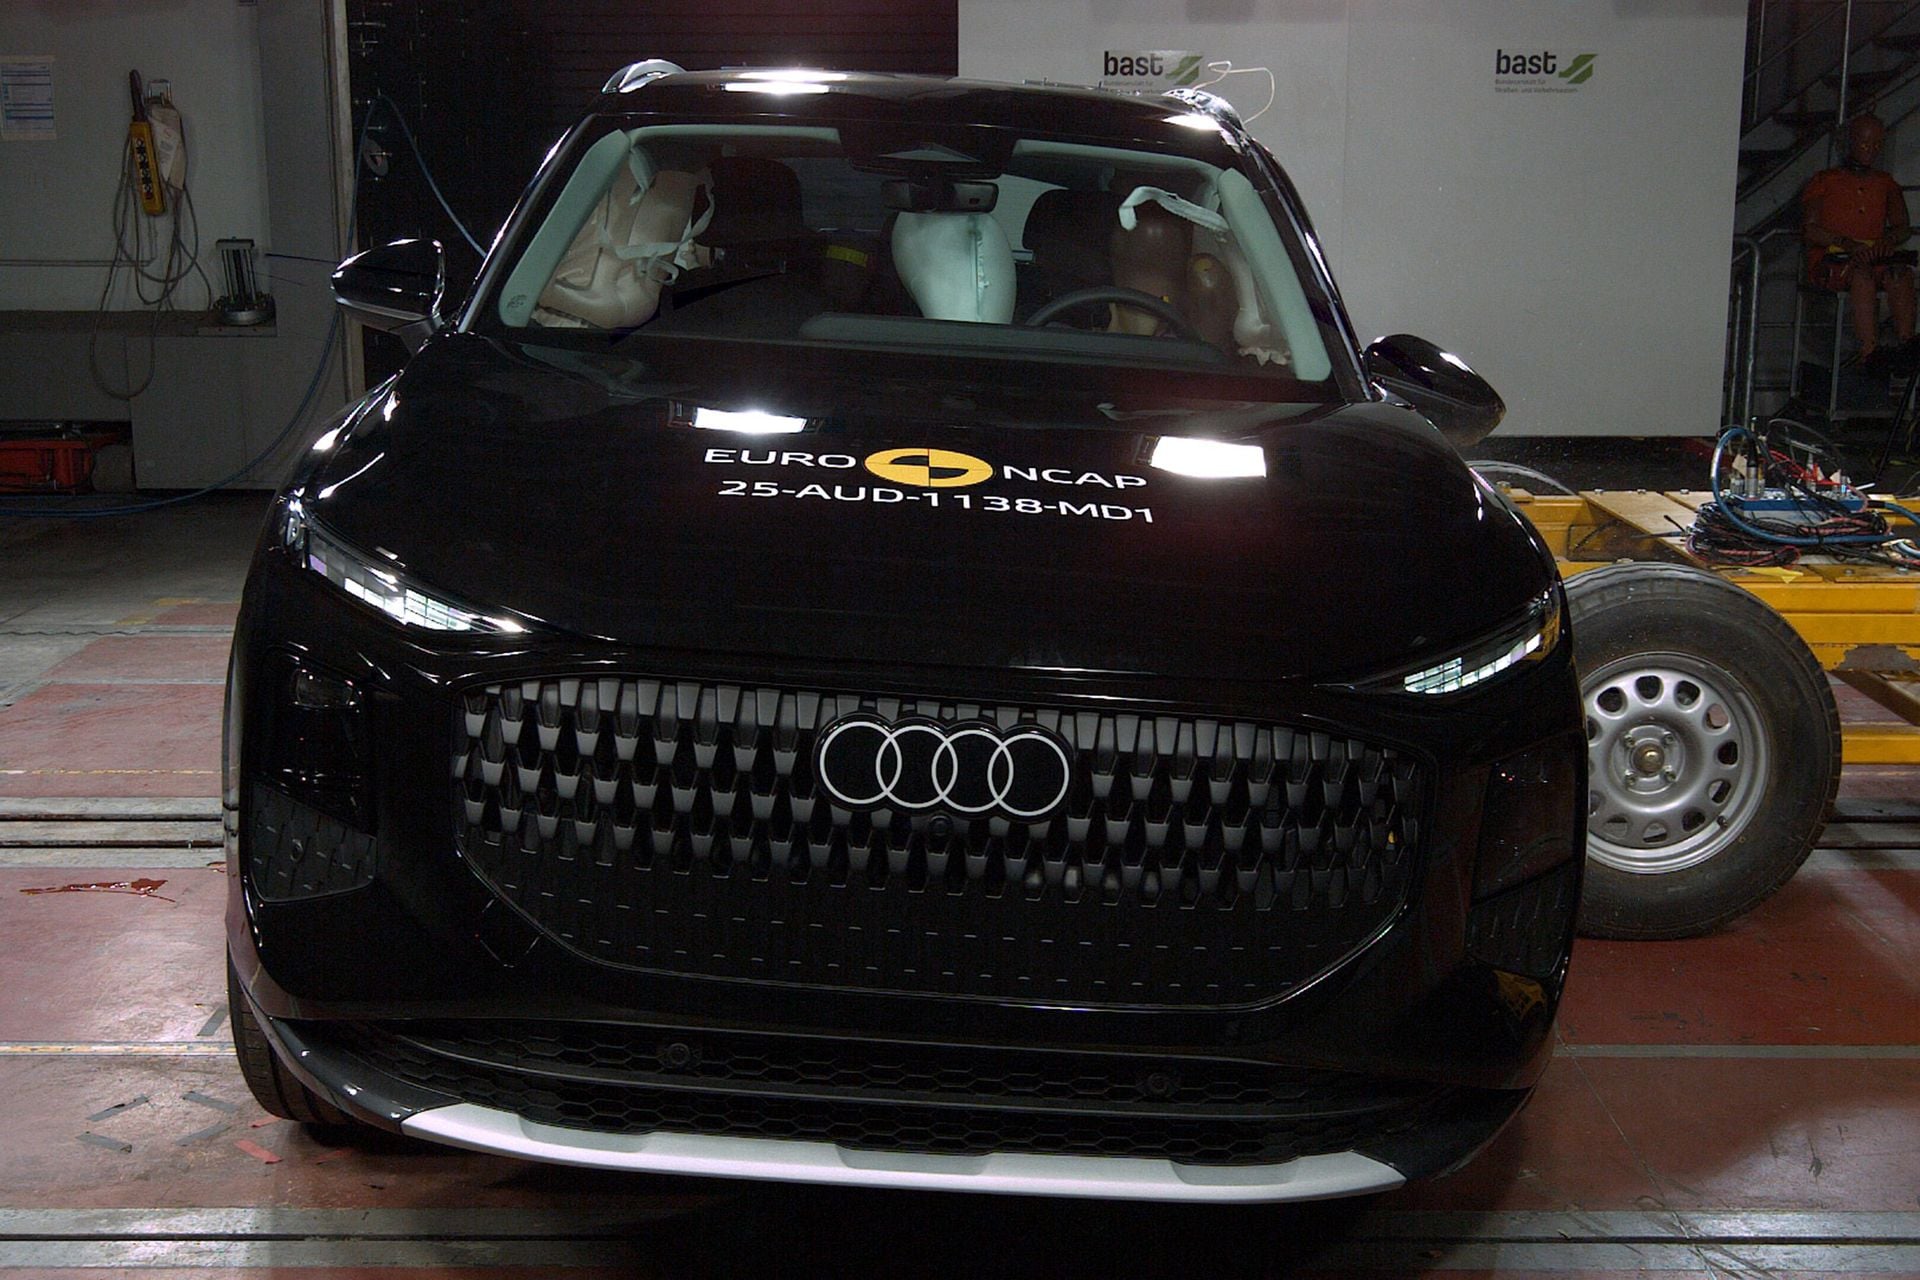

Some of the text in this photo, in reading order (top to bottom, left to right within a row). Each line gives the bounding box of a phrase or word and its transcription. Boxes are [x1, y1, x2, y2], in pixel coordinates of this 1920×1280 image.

[1104, 51, 1163, 76] bast
[1496, 49, 1556, 75] bast
[704, 448, 1147, 489] EURO NCAP
[718, 480, 1154, 523] 25-AUD-1138-MD1
